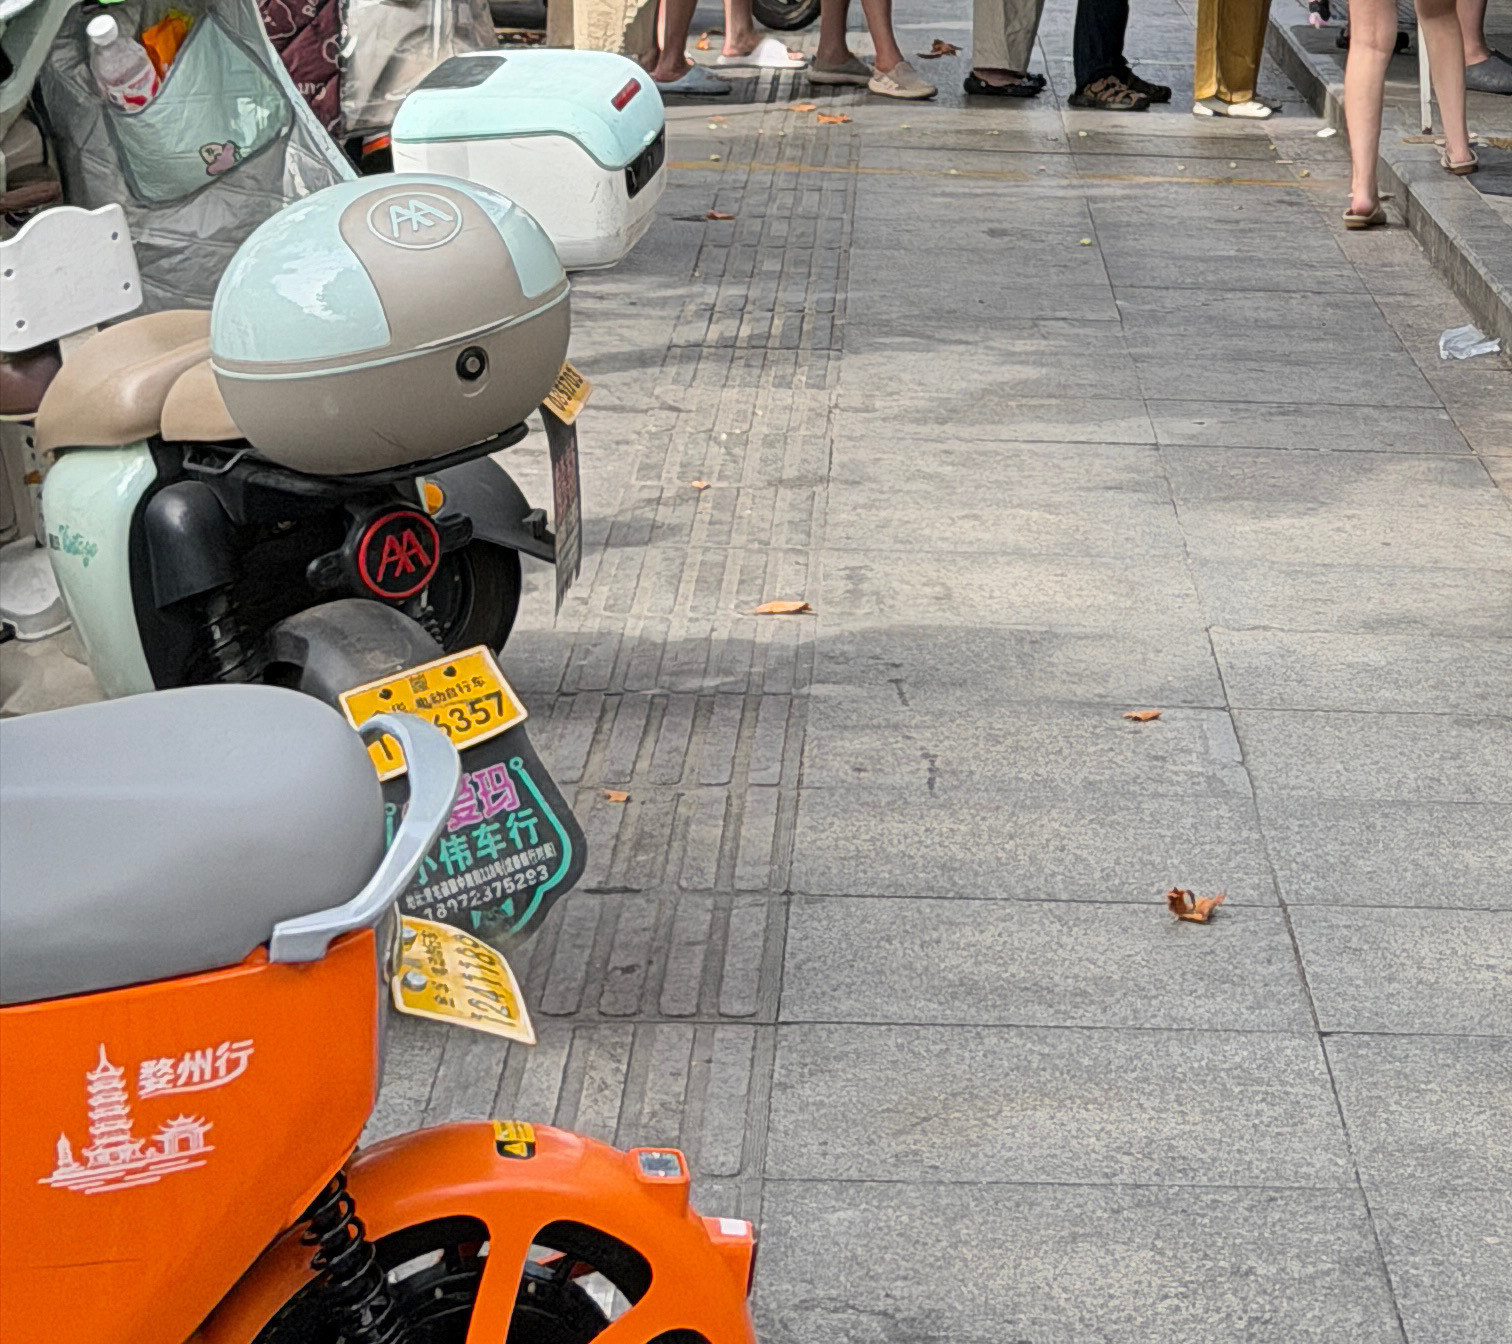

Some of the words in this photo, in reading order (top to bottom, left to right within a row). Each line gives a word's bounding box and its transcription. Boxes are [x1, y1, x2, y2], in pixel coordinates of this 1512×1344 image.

[380, 692, 505, 762] 16357
[416, 807, 539, 886] 小伟车行
[138, 1040, 255, 1099] 婺州行
